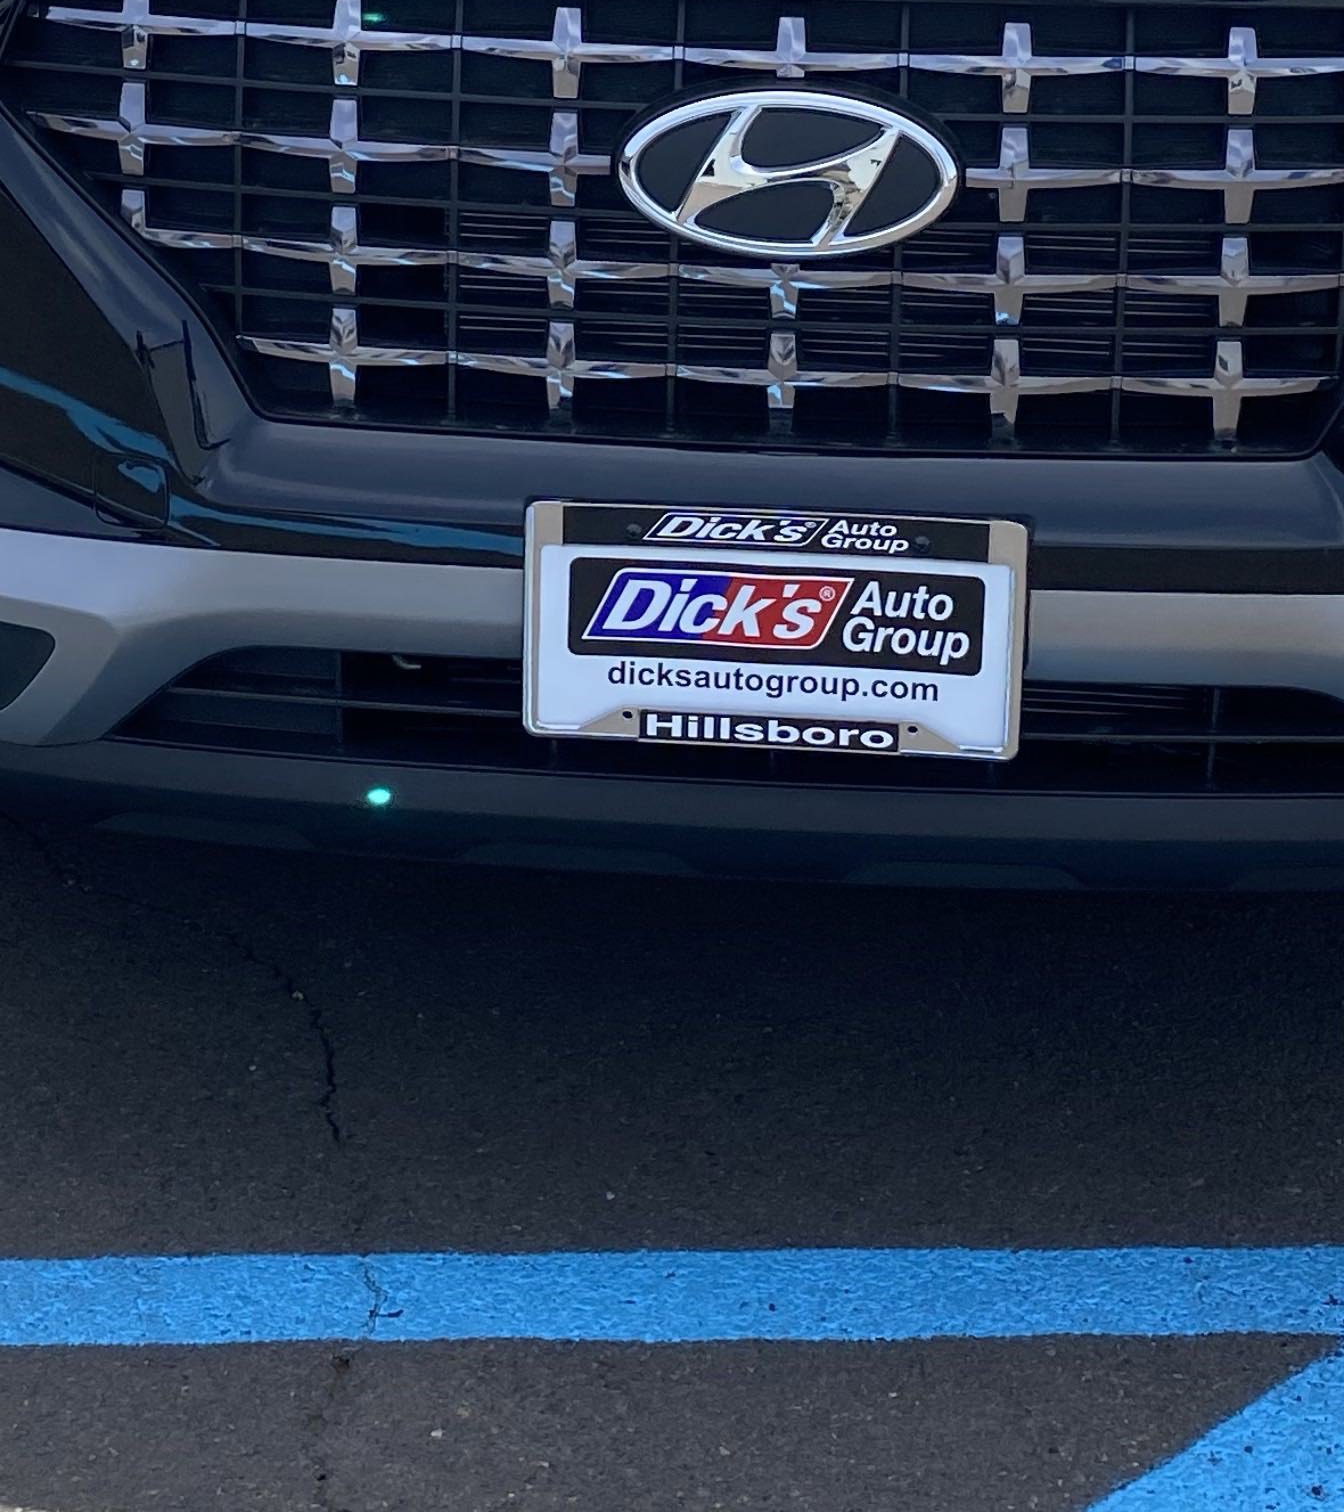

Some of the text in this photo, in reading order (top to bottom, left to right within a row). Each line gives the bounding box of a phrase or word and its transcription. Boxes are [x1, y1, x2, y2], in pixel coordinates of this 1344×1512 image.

[656, 516, 808, 543] Dick's
[820, 532, 910, 554] Group
[827, 518, 898, 537] Auto
[601, 577, 823, 640] Dick's
[850, 580, 955, 621] Auto
[841, 617, 971, 666] Group
[607, 660, 940, 702] dicksautogroup.com
[645, 713, 895, 749] Hillsboro
